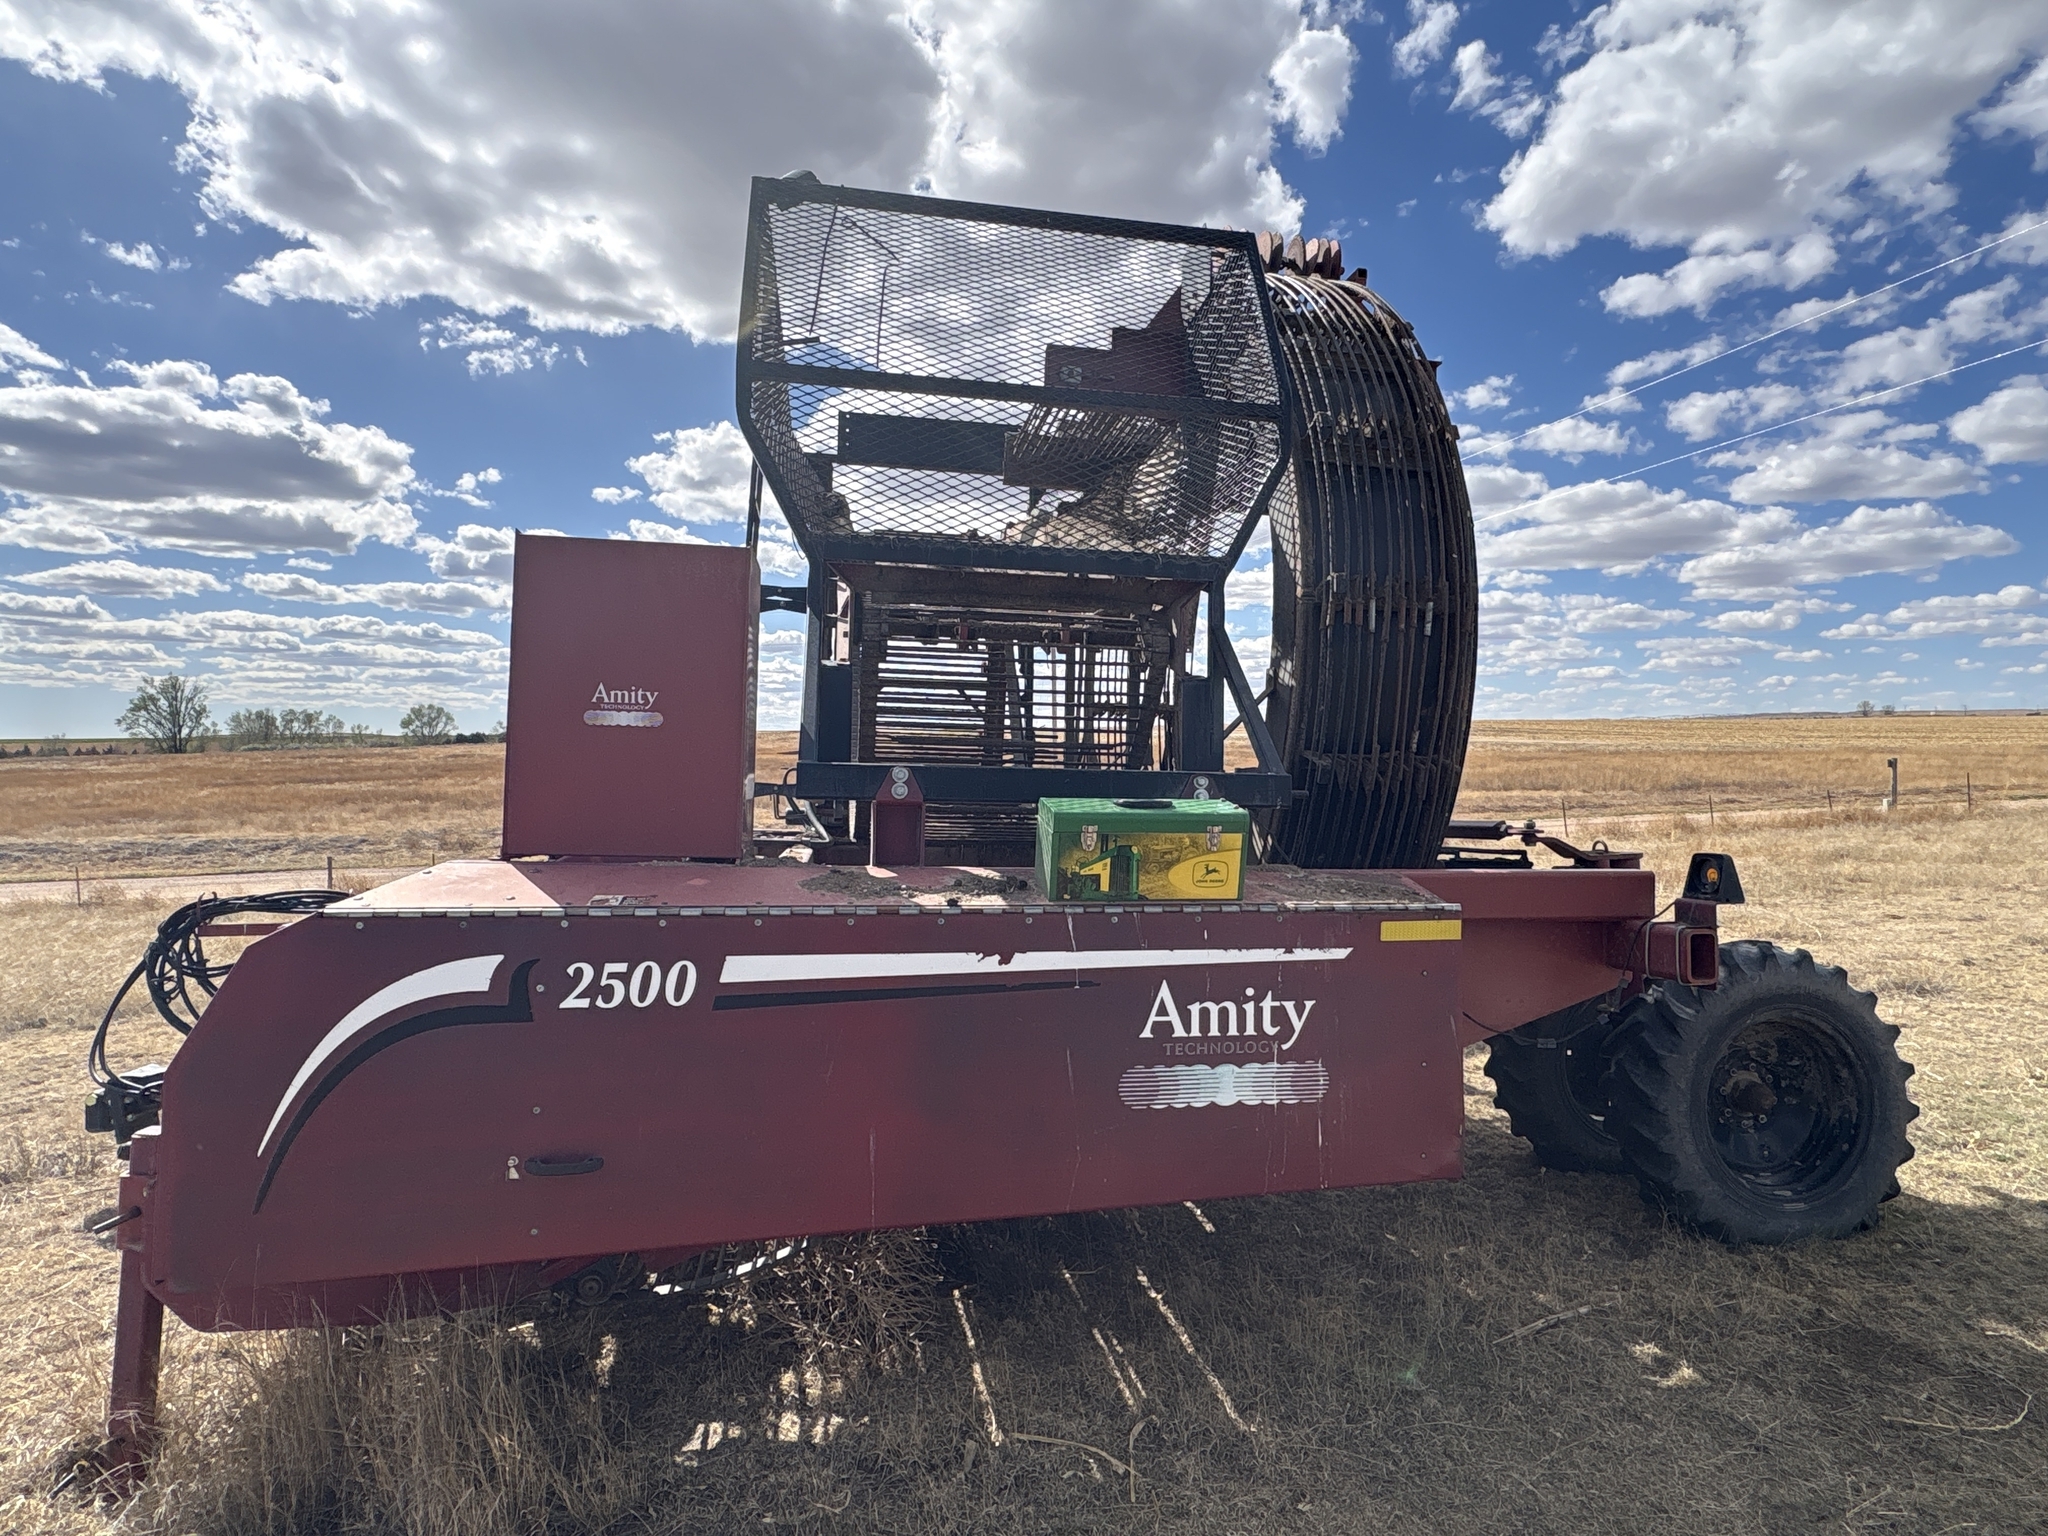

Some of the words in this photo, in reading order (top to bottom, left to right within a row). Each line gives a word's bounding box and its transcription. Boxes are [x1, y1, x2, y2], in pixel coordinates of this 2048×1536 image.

[591, 682, 659, 709] Amity
[558, 960, 697, 1009] 2500
[1139, 979, 1316, 1050] Amity
[1163, 1041, 1279, 1055] TECHNOLOGY
